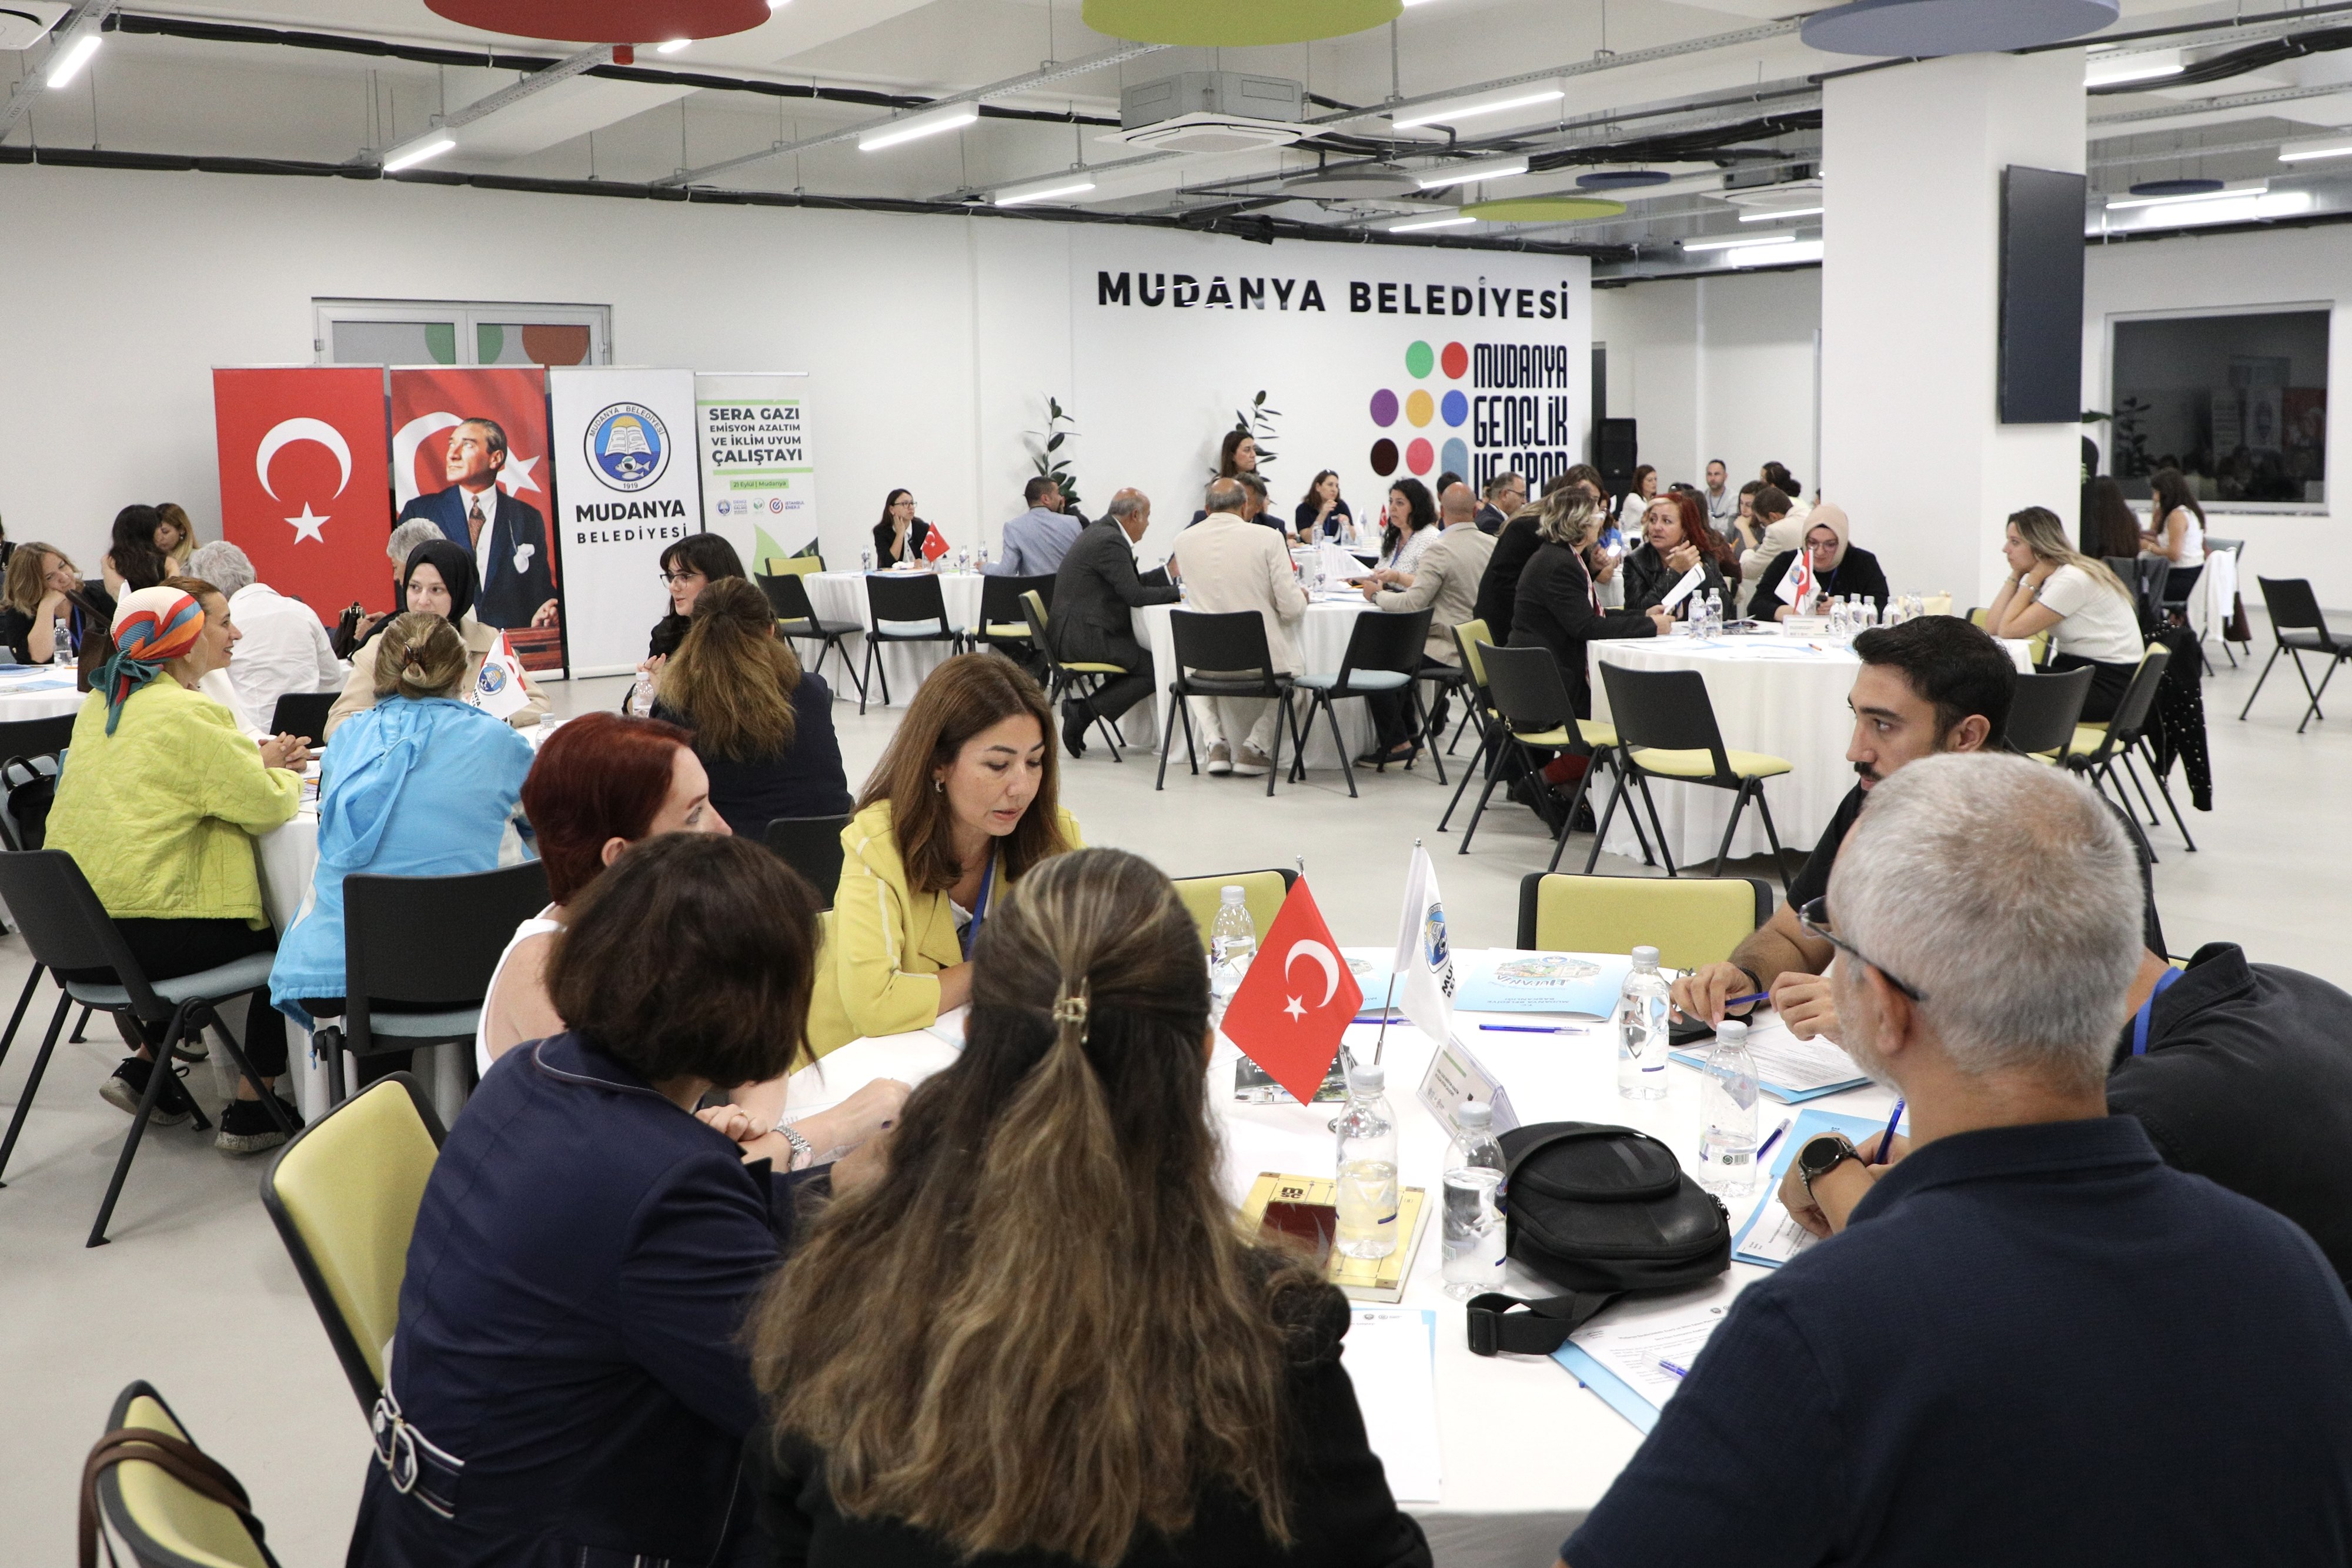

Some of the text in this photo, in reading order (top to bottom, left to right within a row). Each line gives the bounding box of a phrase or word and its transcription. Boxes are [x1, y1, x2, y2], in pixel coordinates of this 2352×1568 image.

[1098, 271, 1568, 320] MUDANYA BELEDİYESİ
[1474, 343, 1567, 389] MUDANYA
[589, 405, 666, 437] MUDANYA BELEDİYESİ
[709, 408, 800, 421] SERA GAZI
[1474, 396, 1567, 450] GENÇLİK
[710, 423, 756, 432] EMİSYON
[711, 434, 801, 446] VE İKLİM UYUM
[711, 449, 803, 467] ÇALIŞTAYI
[576, 500, 686, 523] MUDANYA
[577, 523, 687, 544] BELEDİYESİ
